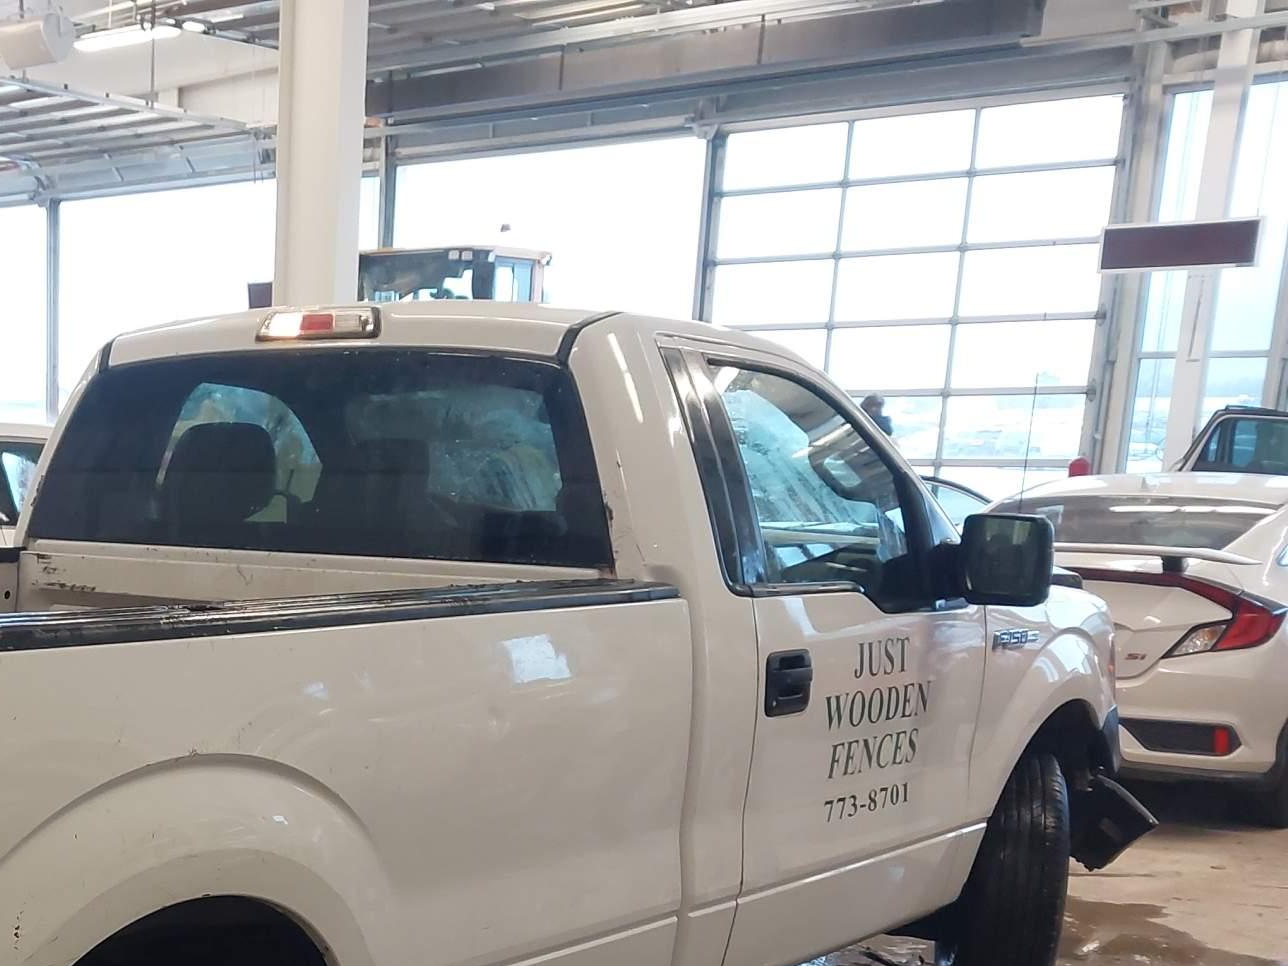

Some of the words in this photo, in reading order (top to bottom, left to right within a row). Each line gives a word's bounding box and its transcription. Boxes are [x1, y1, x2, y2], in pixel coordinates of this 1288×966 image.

[854, 637, 910, 679] JUST
[825, 680, 932, 731] WOODEN
[827, 728, 919, 779] FENCES
[824, 782, 909, 823] 773-8701
